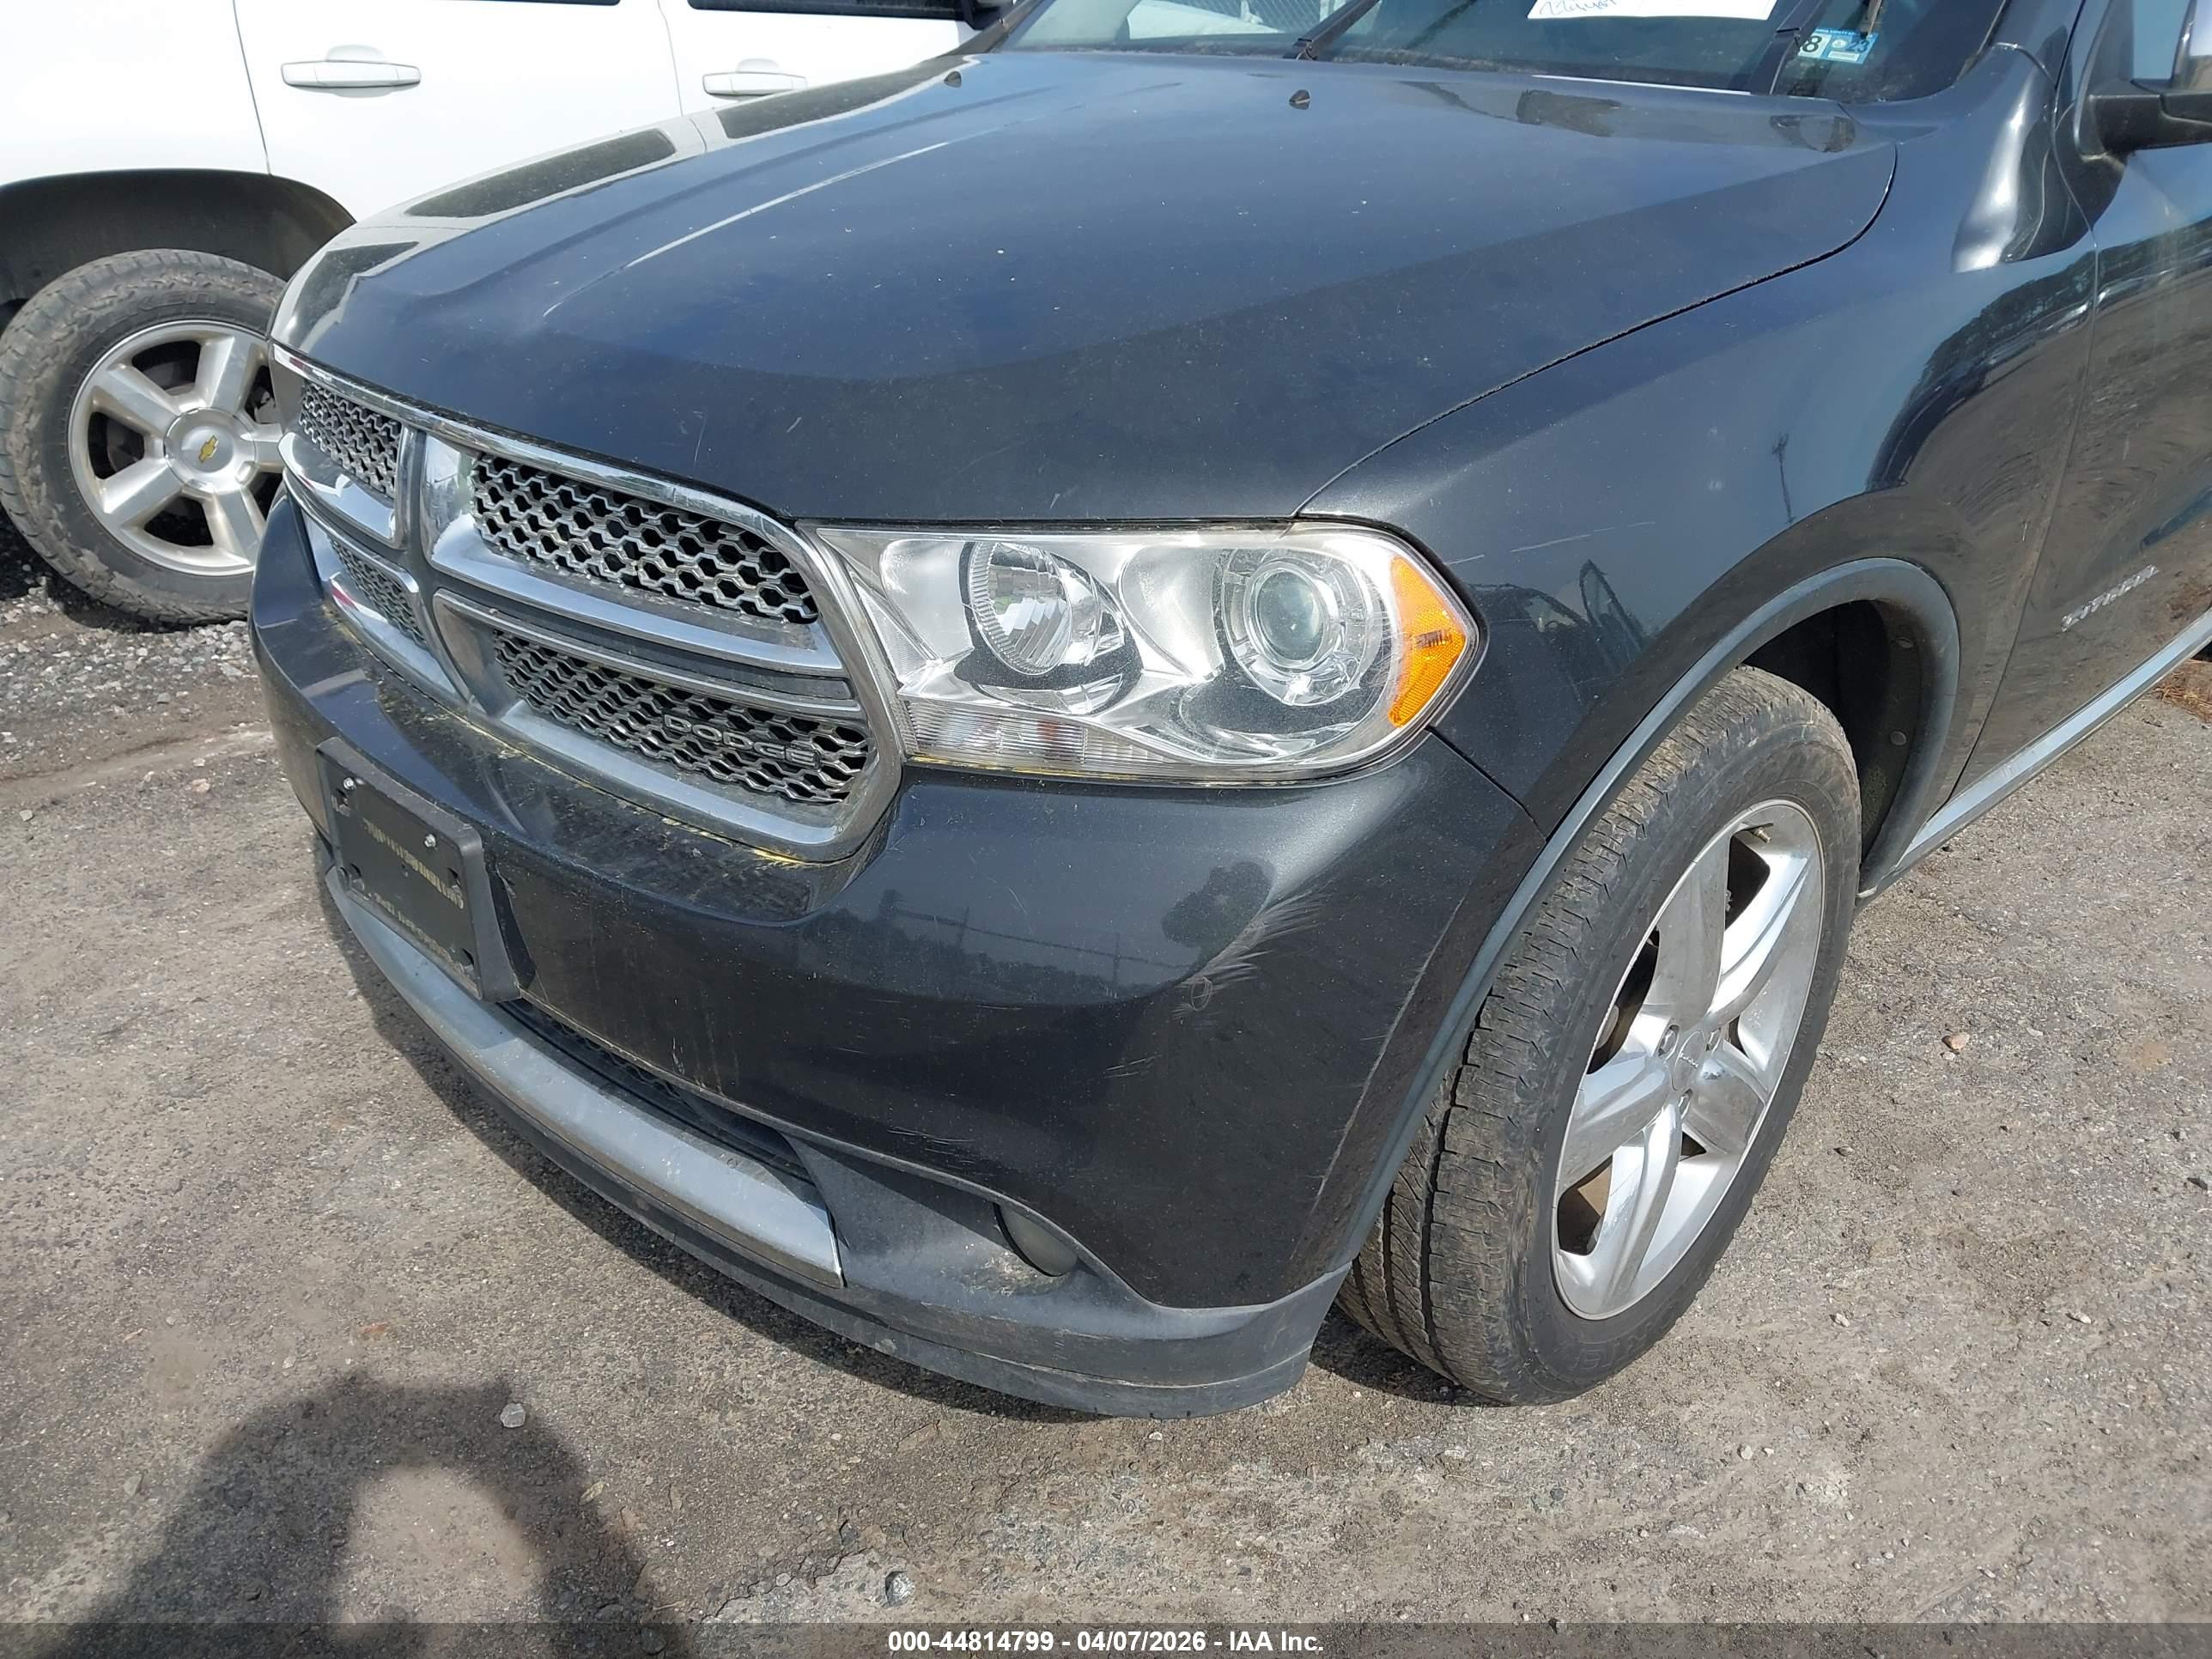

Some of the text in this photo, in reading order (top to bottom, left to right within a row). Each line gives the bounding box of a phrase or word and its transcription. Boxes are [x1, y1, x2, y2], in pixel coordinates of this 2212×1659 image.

[1802, 35, 1870, 53] 8 23
[664, 714, 817, 767] DODGE
